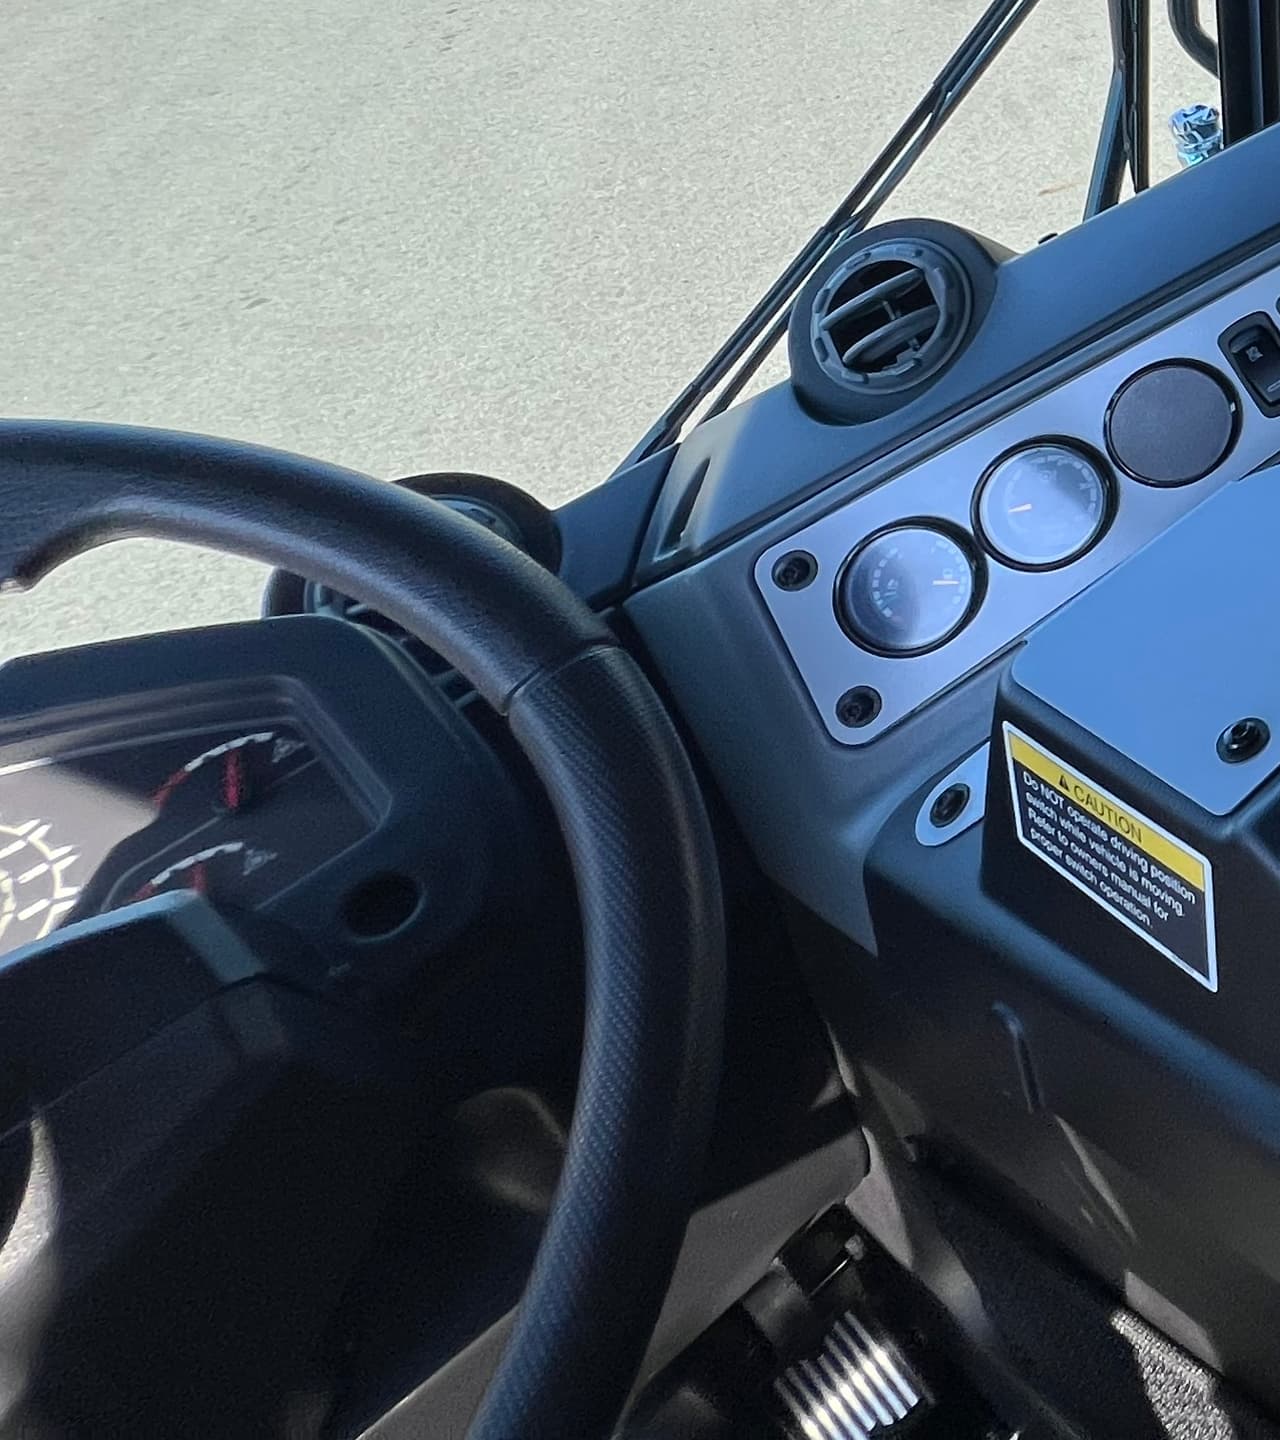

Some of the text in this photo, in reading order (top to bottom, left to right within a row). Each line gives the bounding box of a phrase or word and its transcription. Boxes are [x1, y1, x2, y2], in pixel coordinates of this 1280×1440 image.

[1023, 771, 1196, 904] Do NOT operate driving position
[1026, 792, 1058, 822] switch
[1059, 816, 1087, 843] while
[1088, 838, 1126, 872] vehicle
[1129, 866, 1139, 881] is
[1030, 828, 1063, 858] proper
[1066, 855, 1098, 885] switch
[1074, 786, 1142, 843] CAUTION
[1028, 808, 1169, 921] Refer to owners manual for
